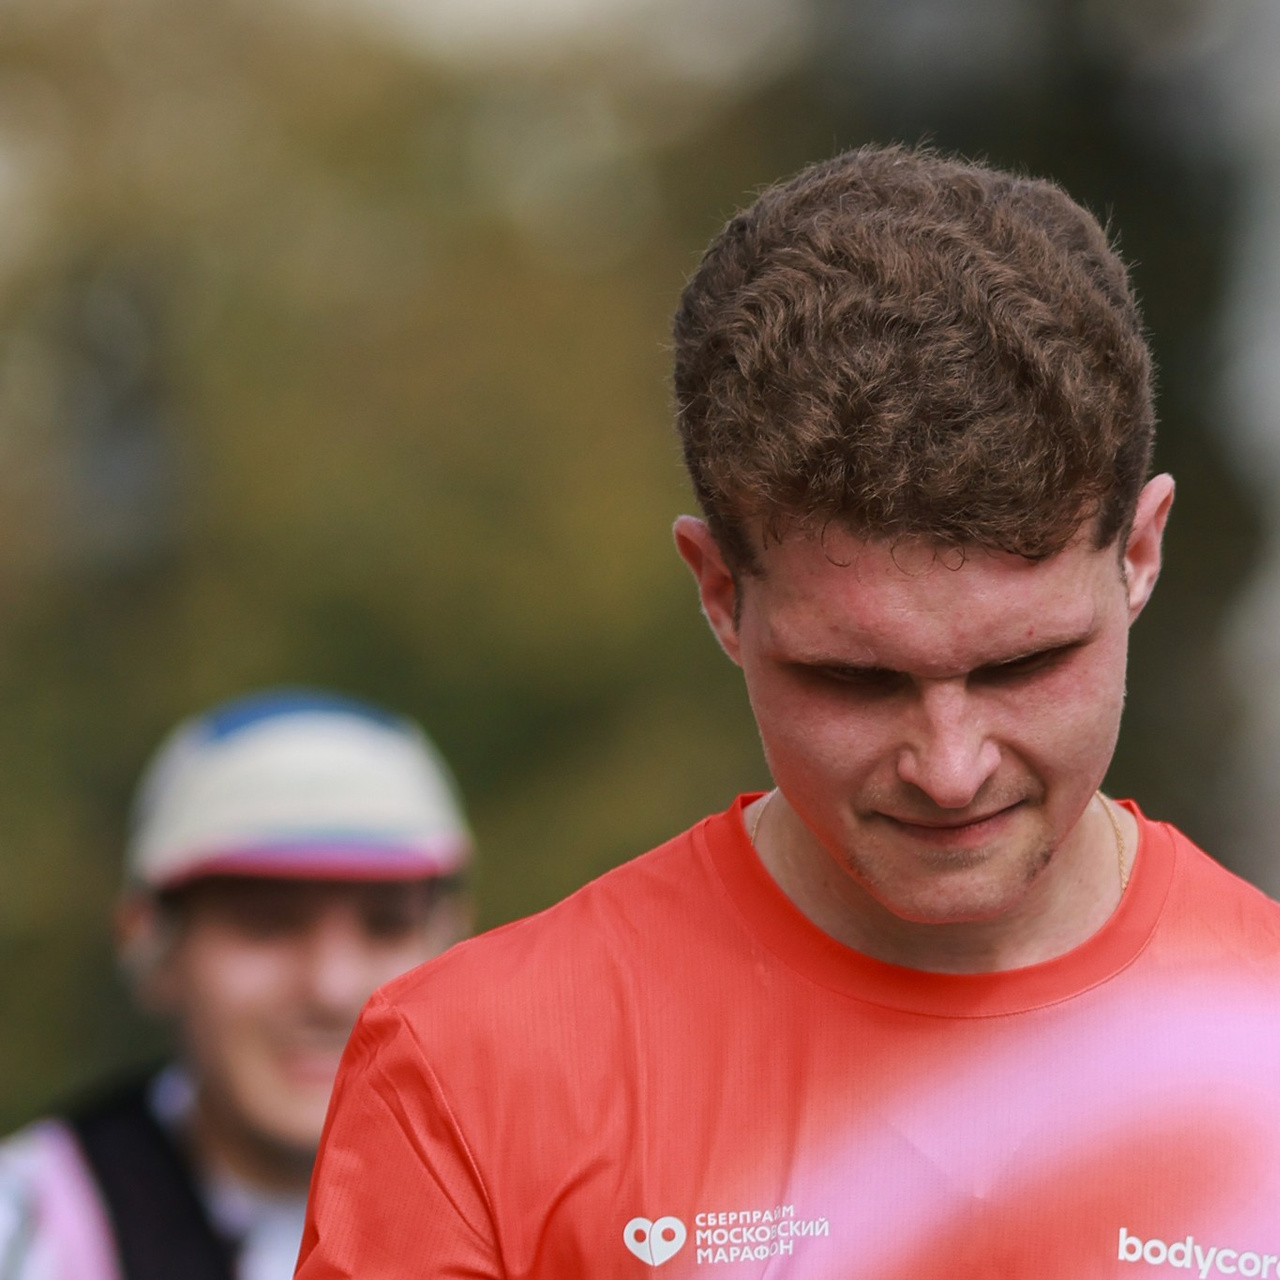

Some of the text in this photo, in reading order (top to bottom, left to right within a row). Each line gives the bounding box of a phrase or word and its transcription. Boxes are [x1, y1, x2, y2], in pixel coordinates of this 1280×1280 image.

[695, 1205, 795, 1226] СБЕРПРАЙМ
[695, 1217, 830, 1246] МОСКОВСКИЙ
[697, 1239, 793, 1264] МАРАФОН
